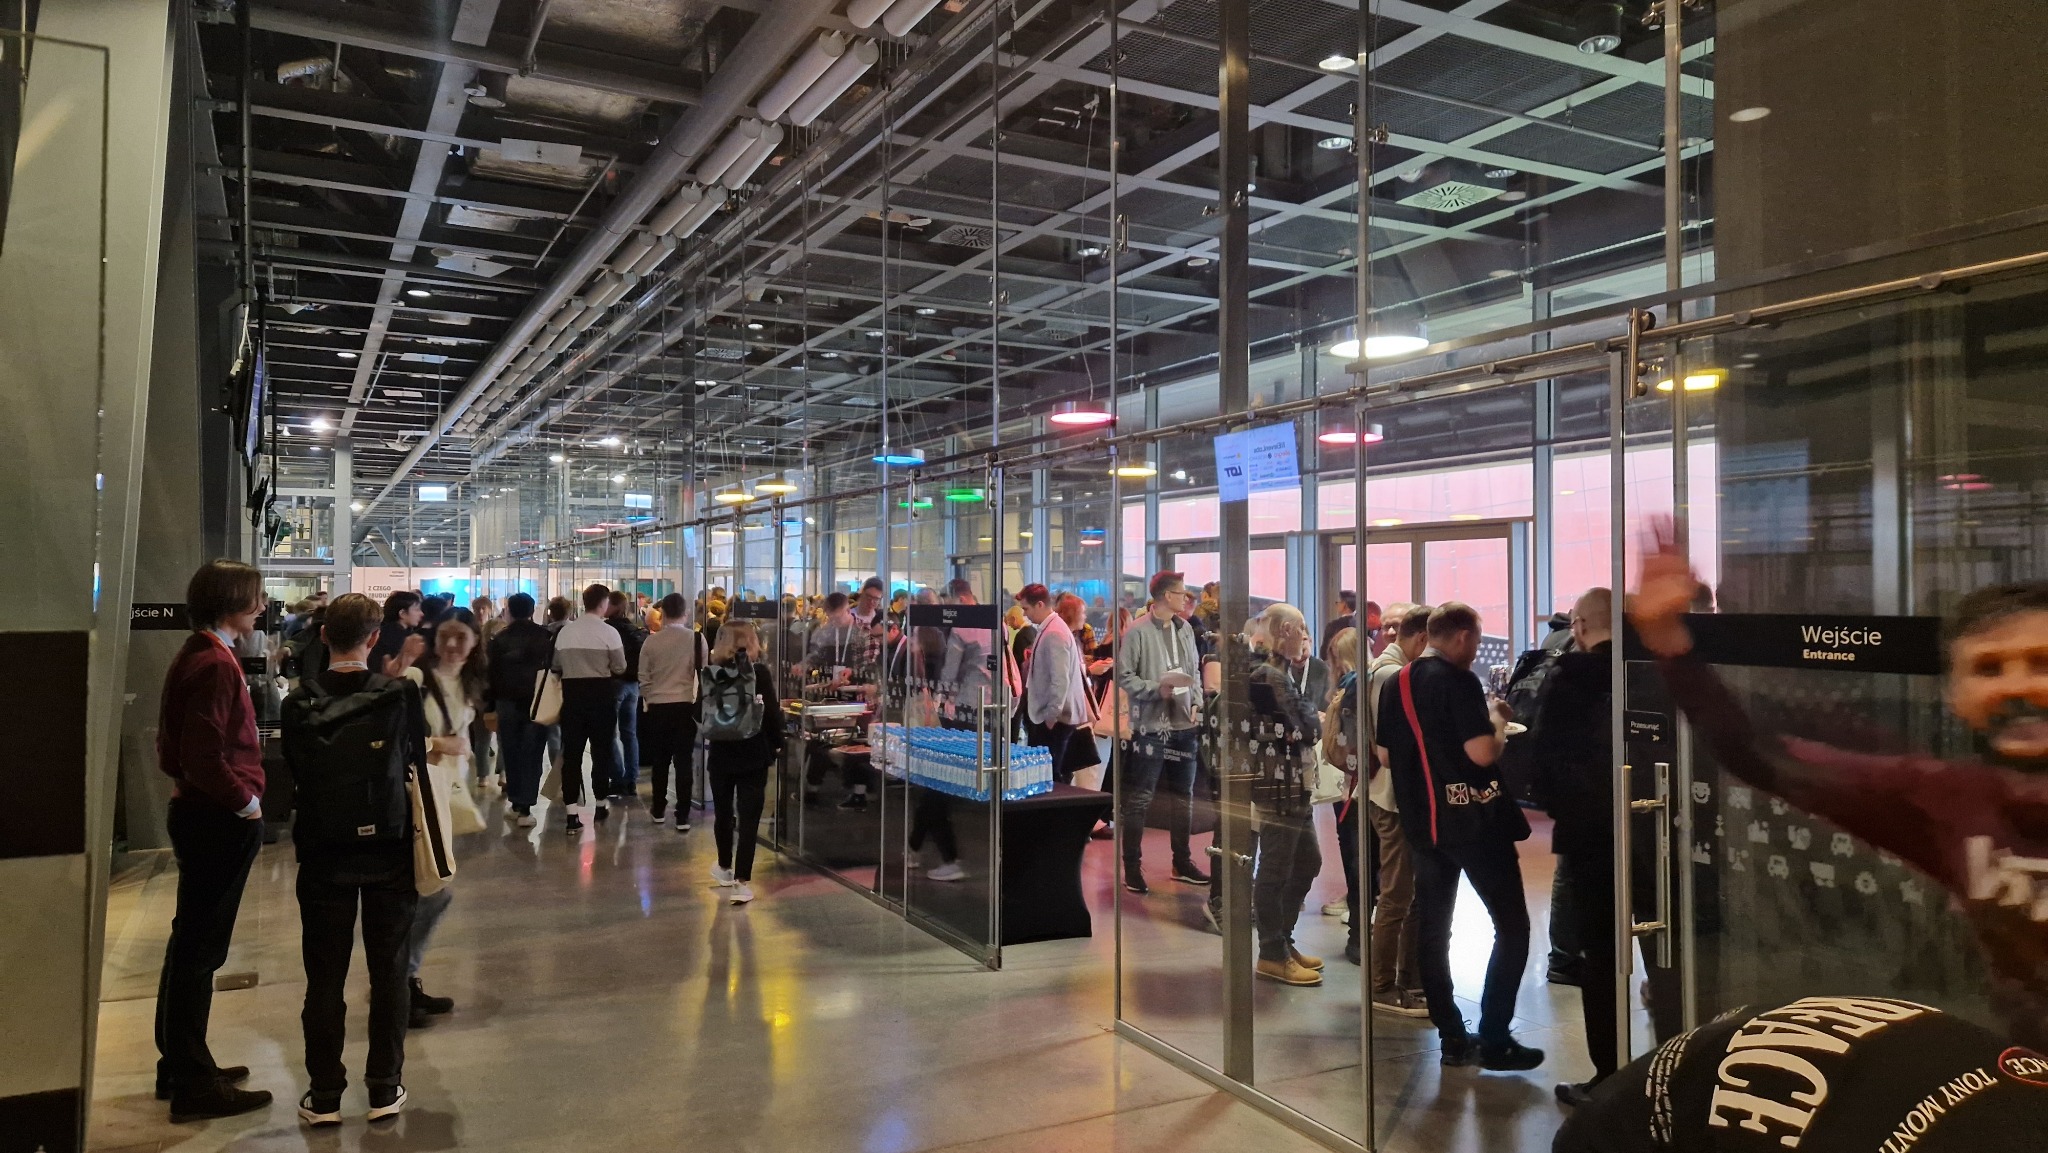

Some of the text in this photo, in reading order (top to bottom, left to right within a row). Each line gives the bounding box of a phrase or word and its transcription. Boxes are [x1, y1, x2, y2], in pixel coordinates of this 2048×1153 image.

[130, 607, 160, 620] jście
[1801, 625, 1882, 648] Wejście
[1803, 649, 1855, 661] Entrance
[1879, 1067, 1998, 1153] TONY MONT
